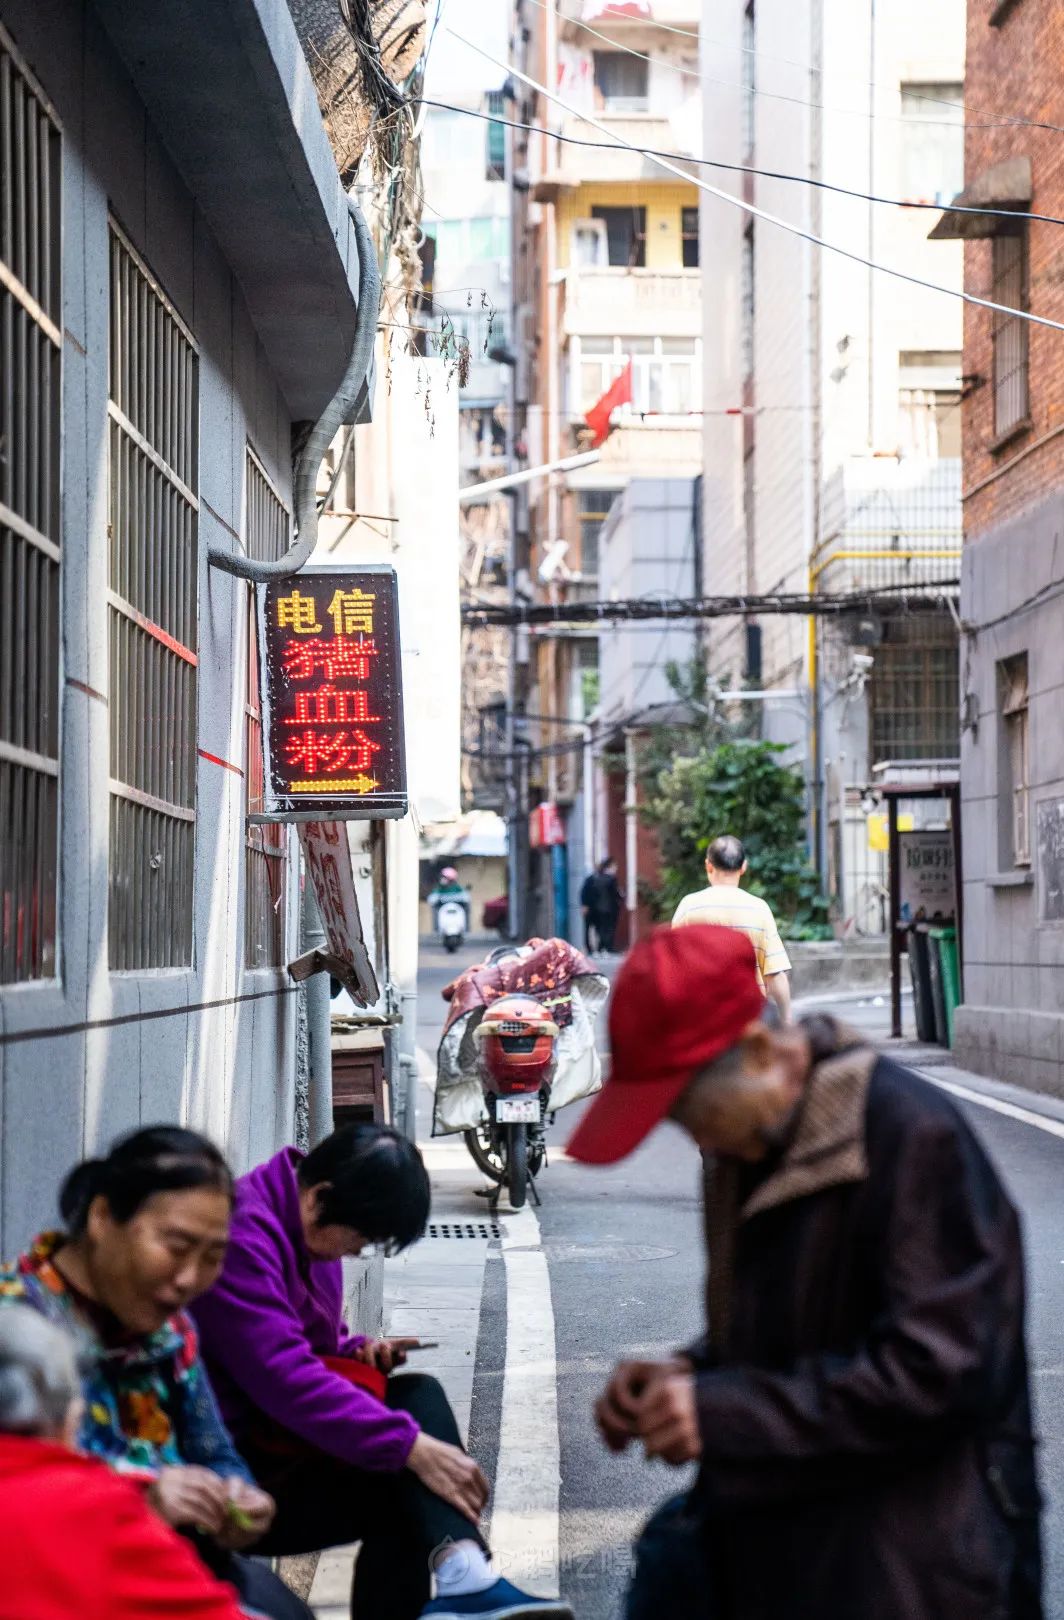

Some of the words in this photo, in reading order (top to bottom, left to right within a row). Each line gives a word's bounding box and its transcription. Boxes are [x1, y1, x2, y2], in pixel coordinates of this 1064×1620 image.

[278, 588, 376, 634] 电信
[282, 635, 382, 774] 猪血粉
